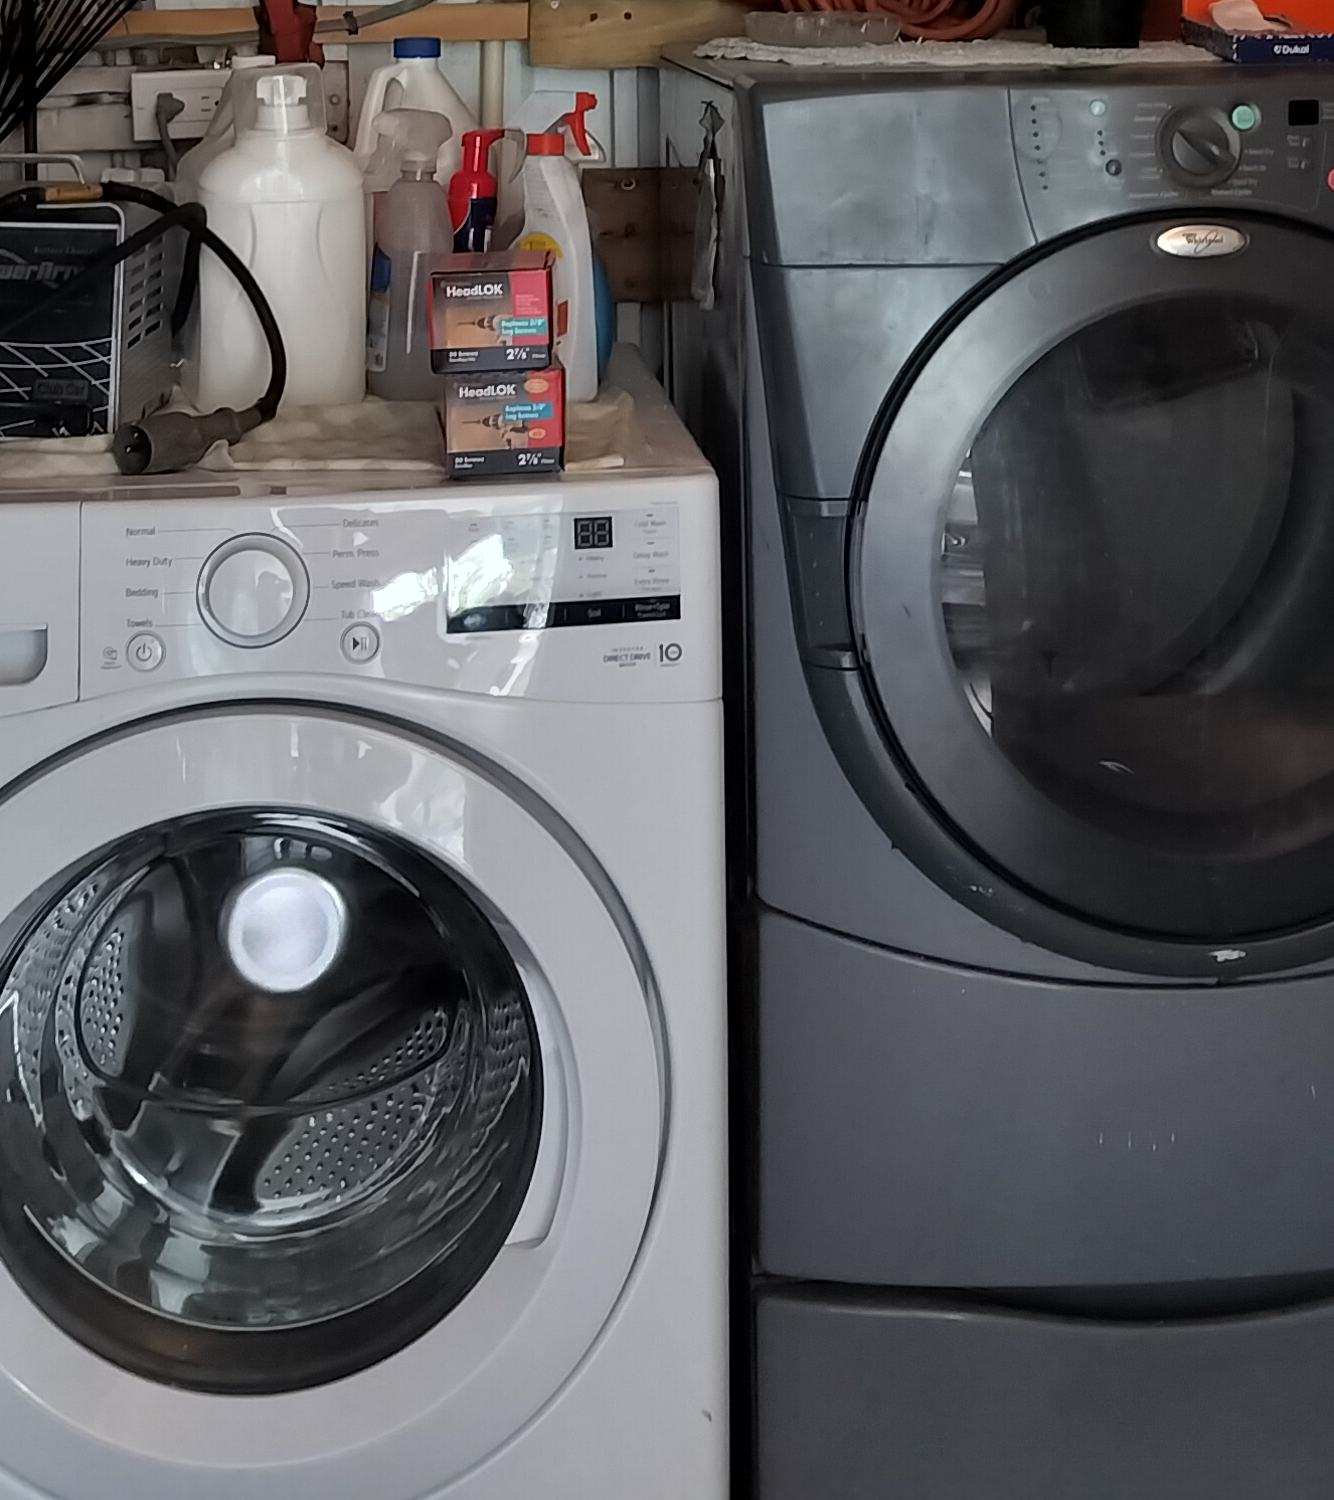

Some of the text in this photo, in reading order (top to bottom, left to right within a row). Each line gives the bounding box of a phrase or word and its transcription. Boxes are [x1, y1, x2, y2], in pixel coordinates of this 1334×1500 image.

[1282, 44, 1310, 55] Dukal
[446, 283, 503, 298] HeadLOK
[458, 384, 517, 399] HeadLOK
[125, 526, 157, 537] Normal
[125, 556, 174, 569] Heavy Duty
[125, 587, 159, 599] Bedding
